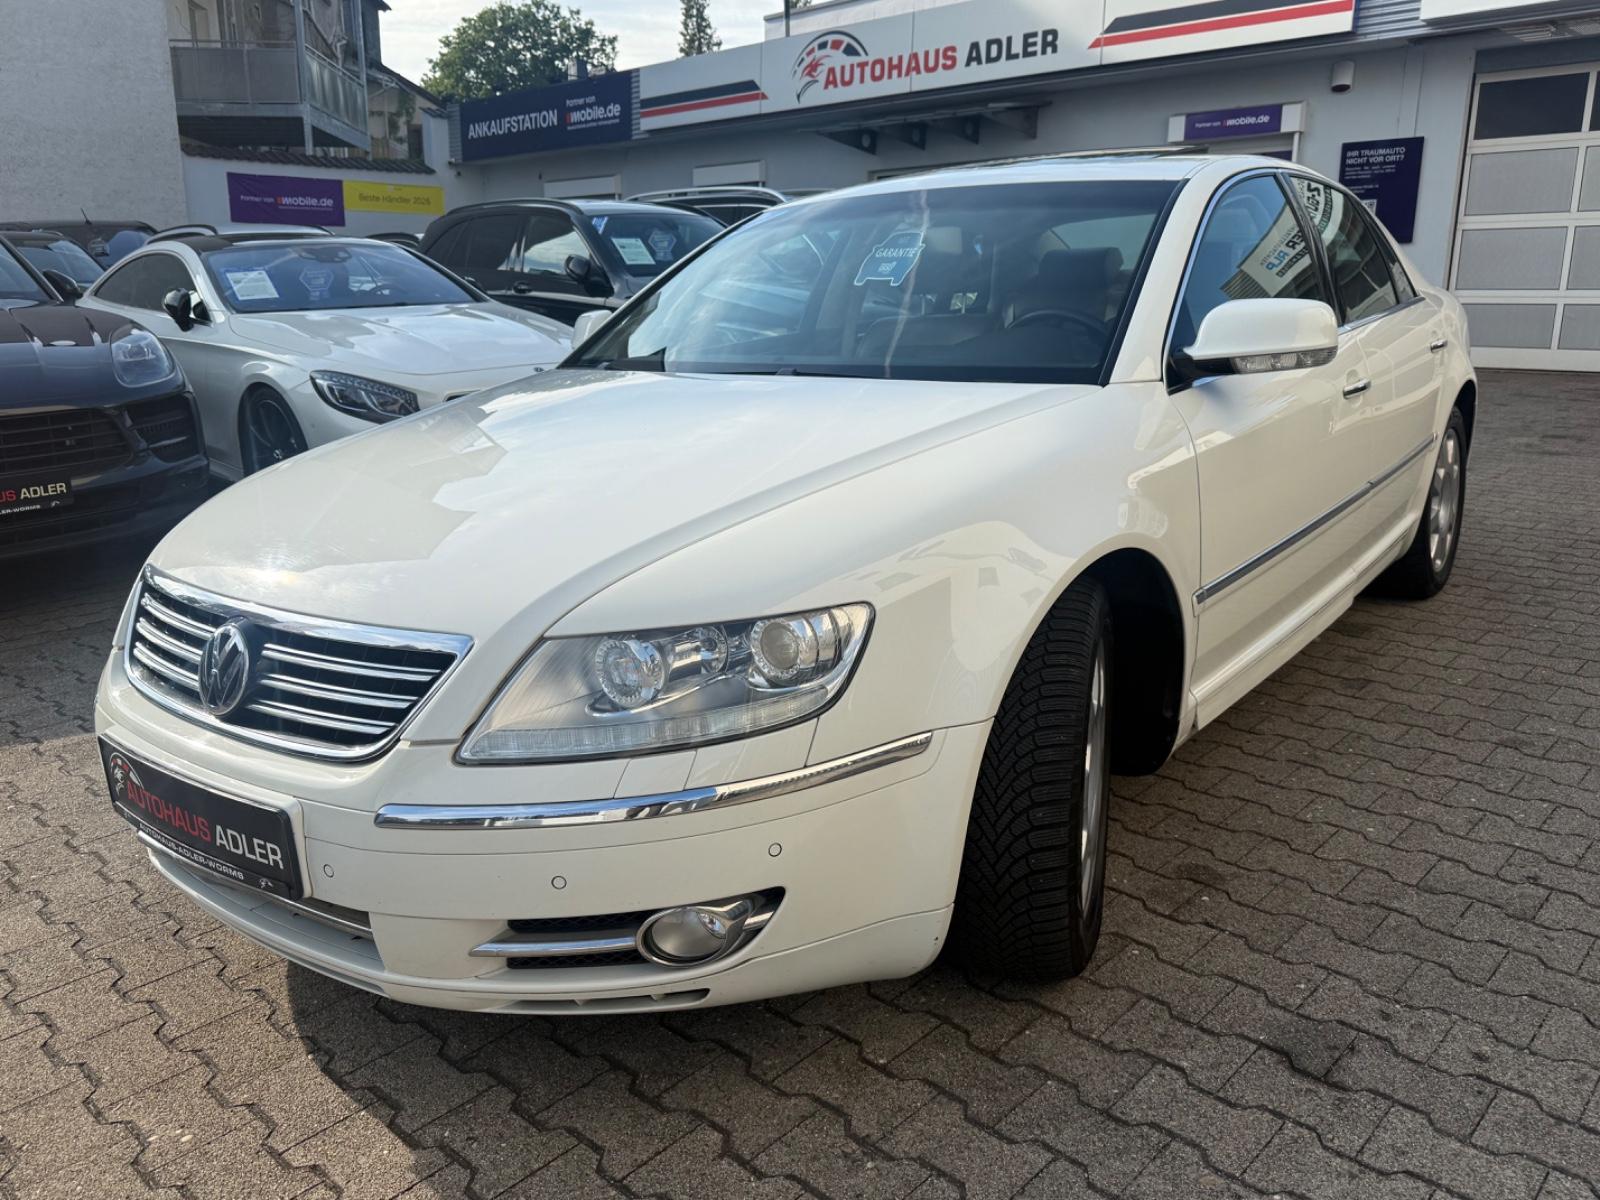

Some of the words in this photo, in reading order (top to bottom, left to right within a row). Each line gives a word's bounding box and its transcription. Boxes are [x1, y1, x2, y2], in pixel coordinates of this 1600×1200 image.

[823, 45, 958, 90] AUTOHAUS
[964, 28, 1059, 68] ADLER
[467, 108, 558, 140] ANKAUFSTATION
[1345, 157, 1367, 165] NICHT
[1368, 156, 1384, 164] VOR
[1385, 154, 1405, 163] ORT?
[1346, 150, 1360, 158] IHR
[1360, 147, 1406, 157] TRAUMAUTO
[358, 192, 381, 203] Beste
[875, 247, 918, 258] GARANTIE
[20, 482, 67, 500] ADLER
[127, 780, 212, 843] AUTOHAUS
[215, 824, 284, 871] ADLER
